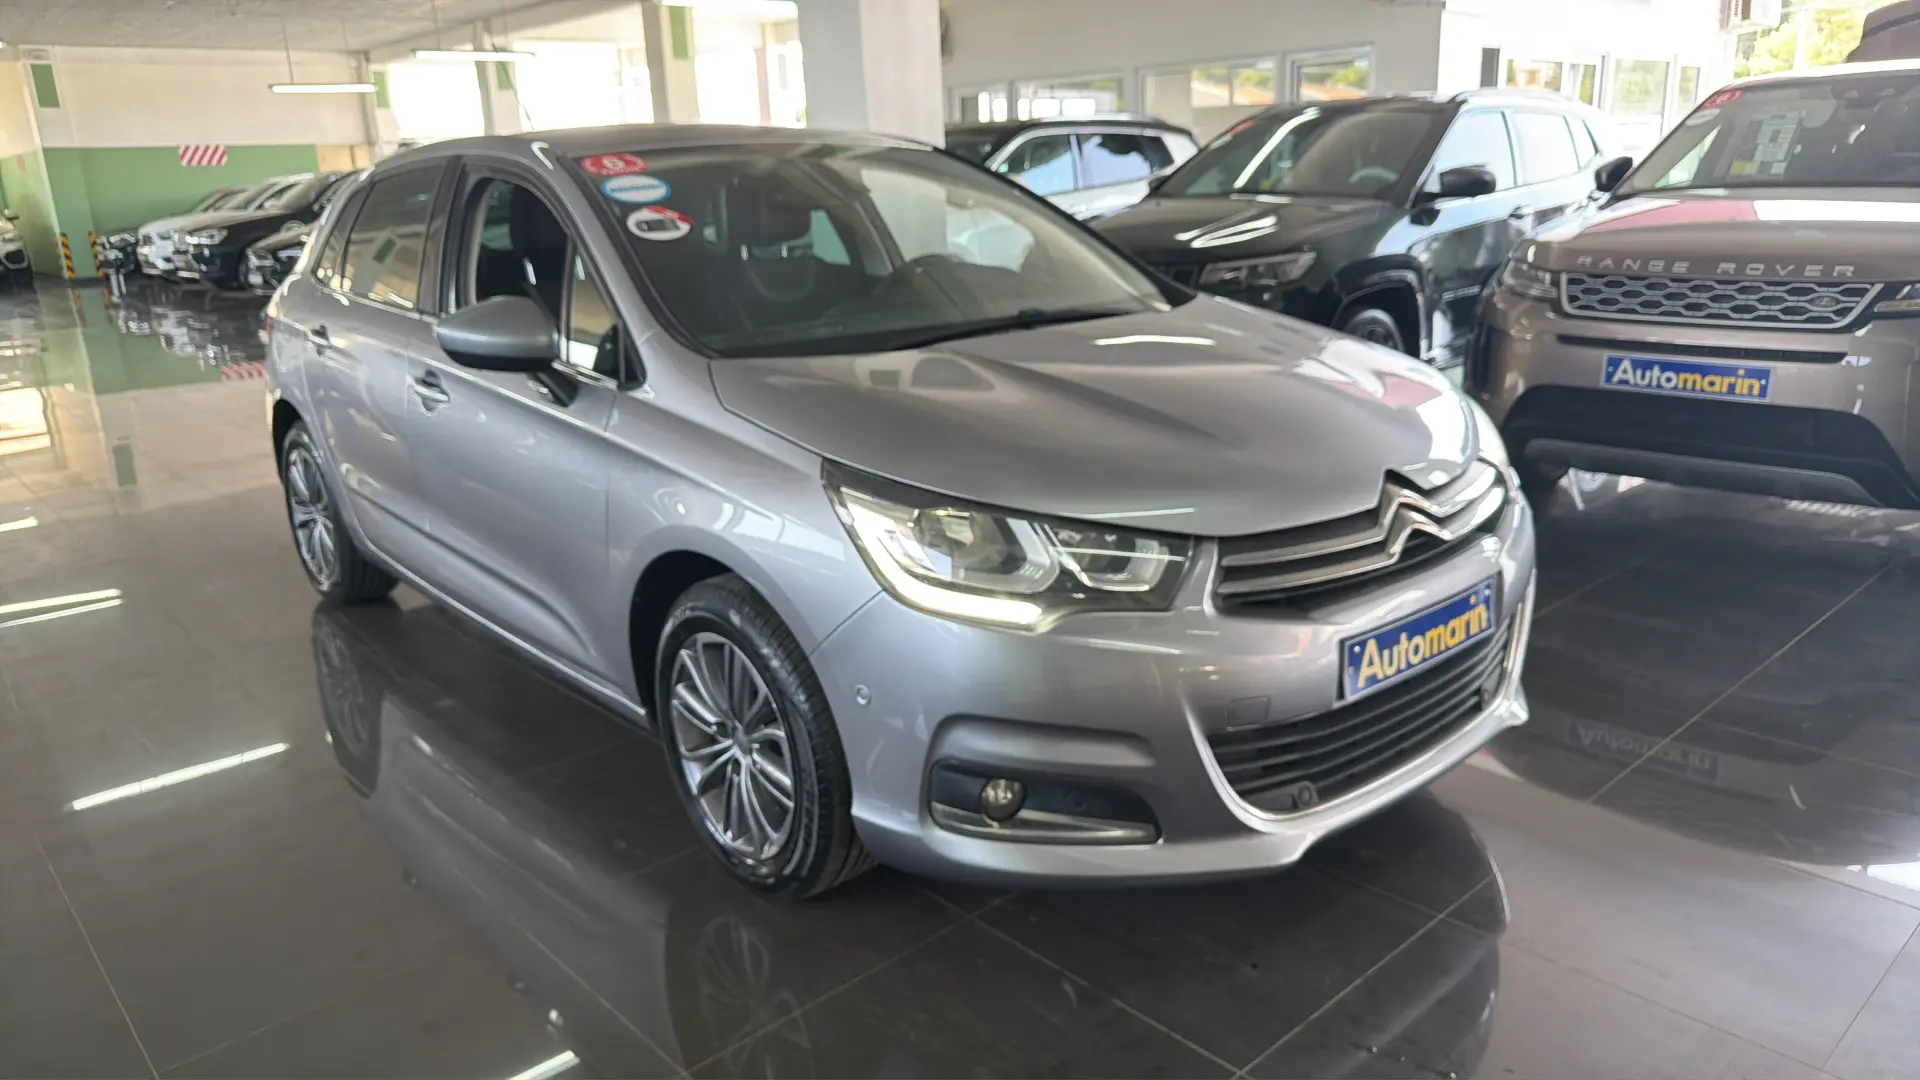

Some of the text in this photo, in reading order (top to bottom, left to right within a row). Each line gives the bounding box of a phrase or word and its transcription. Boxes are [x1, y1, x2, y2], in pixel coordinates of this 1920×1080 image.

[1577, 255, 1855, 278] RANGE ROVER
[1611, 358, 1761, 397] Automarin
[1357, 594, 1488, 689] Automarin
